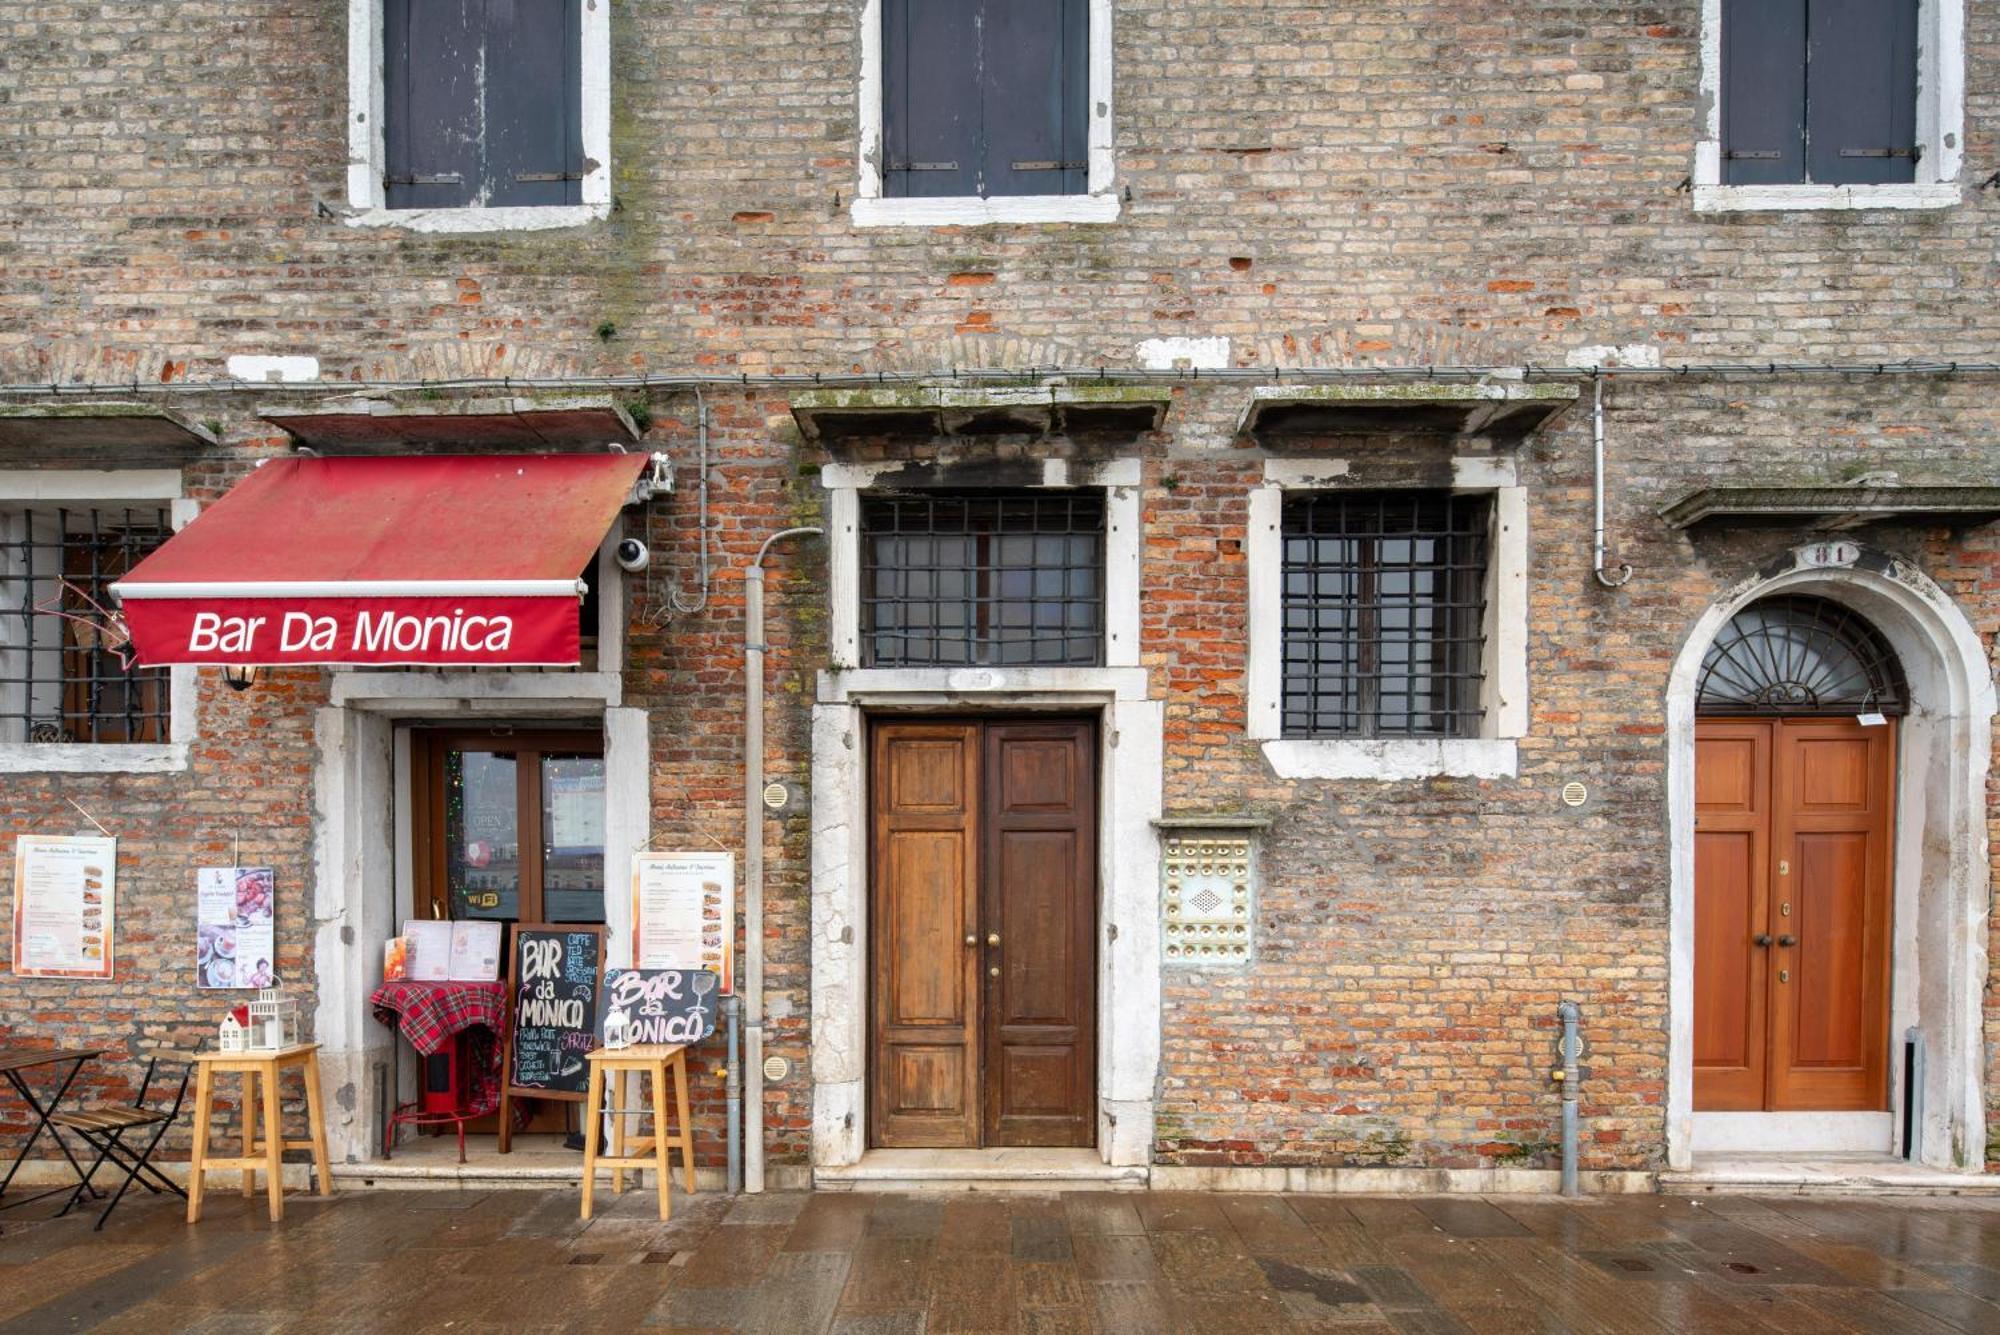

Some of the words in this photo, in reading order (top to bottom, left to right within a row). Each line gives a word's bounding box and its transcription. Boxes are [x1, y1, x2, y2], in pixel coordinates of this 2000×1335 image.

[189, 611, 266, 652] Bar
[280, 612, 338, 652] Da
[352, 608, 513, 652] Monica
[522, 939, 562, 985] BAR
[536, 979, 556, 1000] da
[610, 970, 684, 1006] BAR
[521, 999, 584, 1029] MONICA
[639, 998, 668, 1015] da
